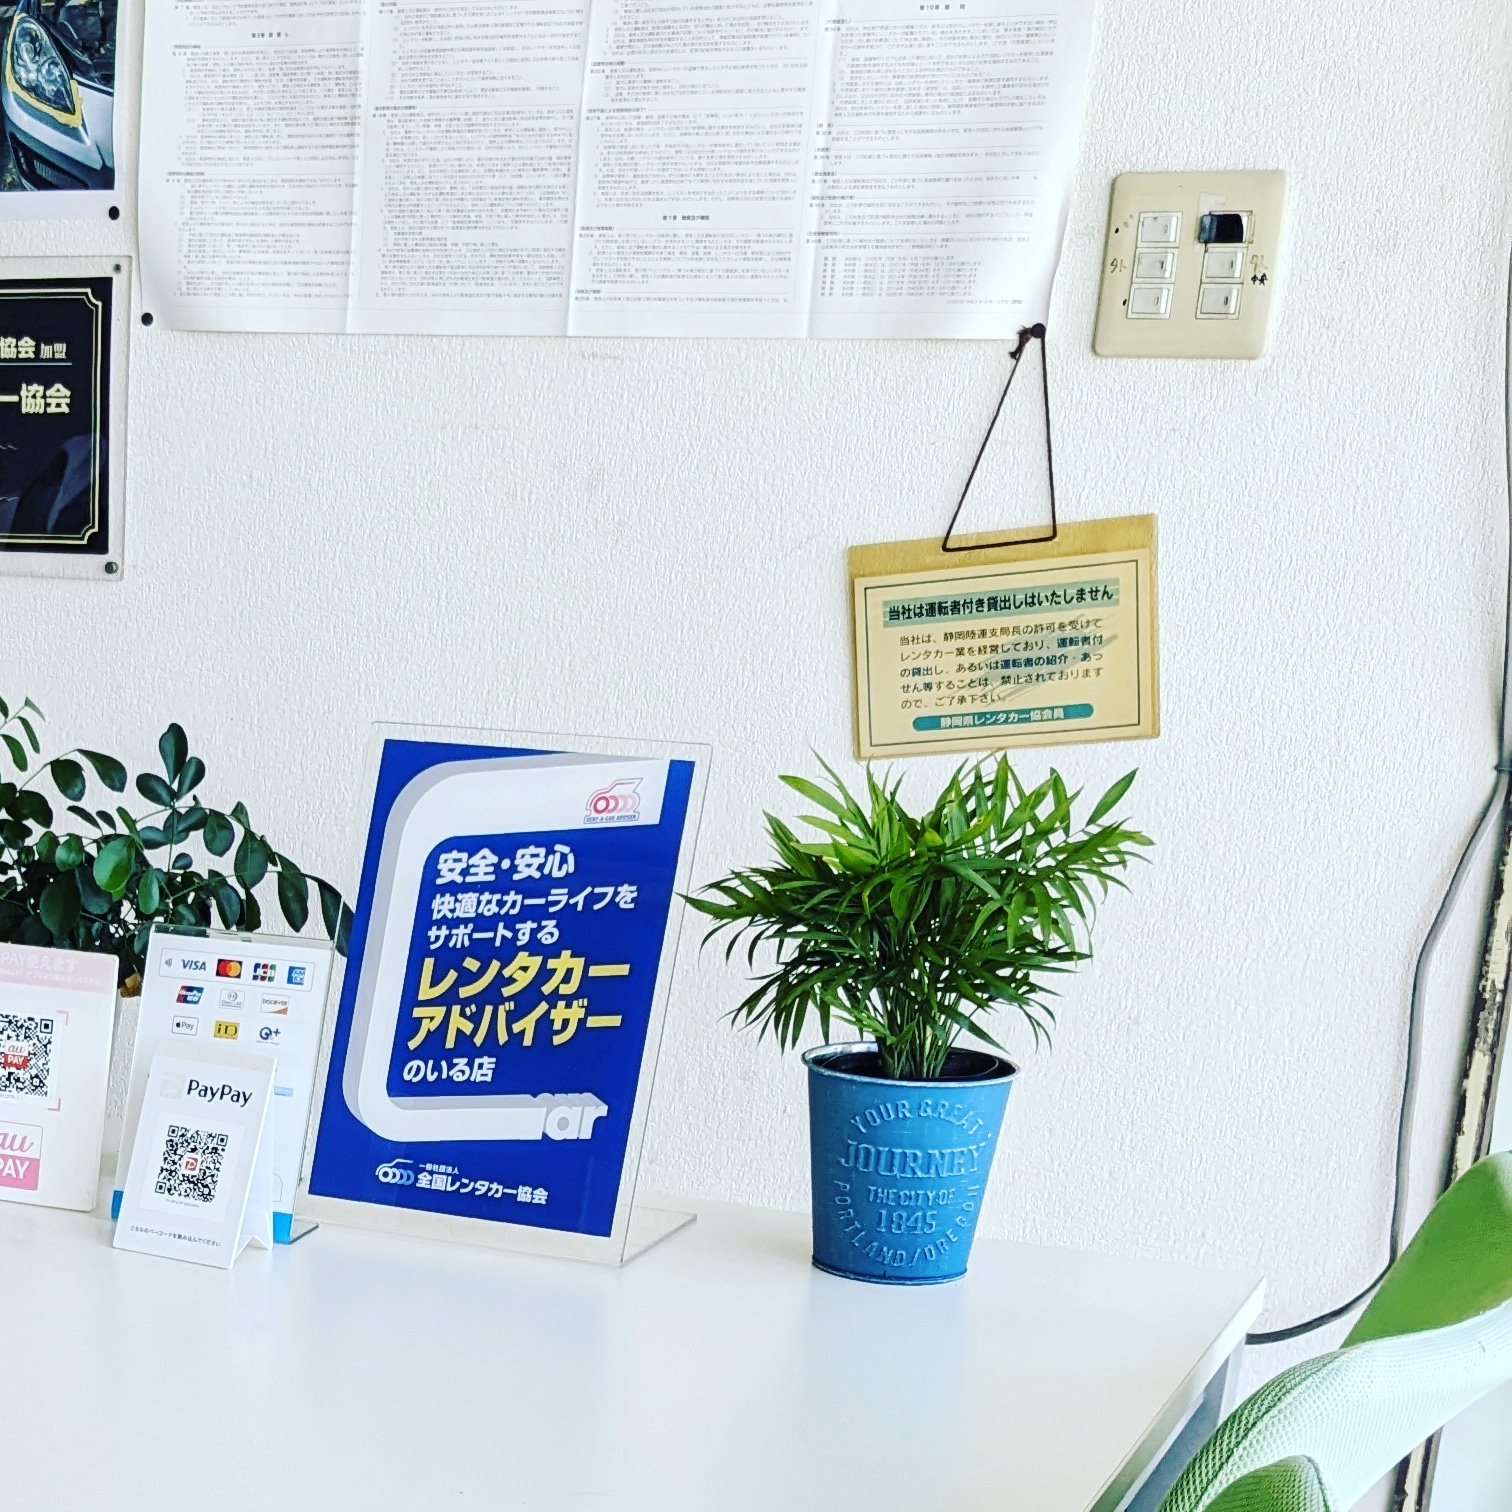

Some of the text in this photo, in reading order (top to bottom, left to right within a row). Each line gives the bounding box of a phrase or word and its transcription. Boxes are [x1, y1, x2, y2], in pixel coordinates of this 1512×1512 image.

[39, 343, 67, 359] 加盟
[888, 585, 1114, 621] 当社は運転者付き貸出しはいたしません
[899, 617, 1103, 646] 当社は、静岡陸運支局長の許可を受けて
[900, 634, 1103, 662] レンタカー業を経営しており、運転者付
[900, 652, 1103, 678] の貸出し、あるいは運転者の紹介・あっ
[940, 707, 1065, 729] 静岡県レンタカー協会員
[436, 844, 575, 885] 安全・安心
[431, 883, 638, 920] 快適なカーライフを
[427, 920, 560, 950] サポートする
[181, 959, 207, 971] VISA
[417, 950, 630, 1001] レンタカー
[181, 1021, 195, 1031] Pay
[406, 998, 623, 1050] アドバイザー
[7, 1055, 25, 1066] PAY
[402, 1057, 496, 1083] のいる店
[187, 1079, 253, 1108] PayPay
[850, 1100, 914, 1134] YOUR
[840, 1139, 988, 1179] JOURNEY
[416, 1171, 549, 1205] 全国レンタカー協会
[876, 1209, 938, 1235] 1845
